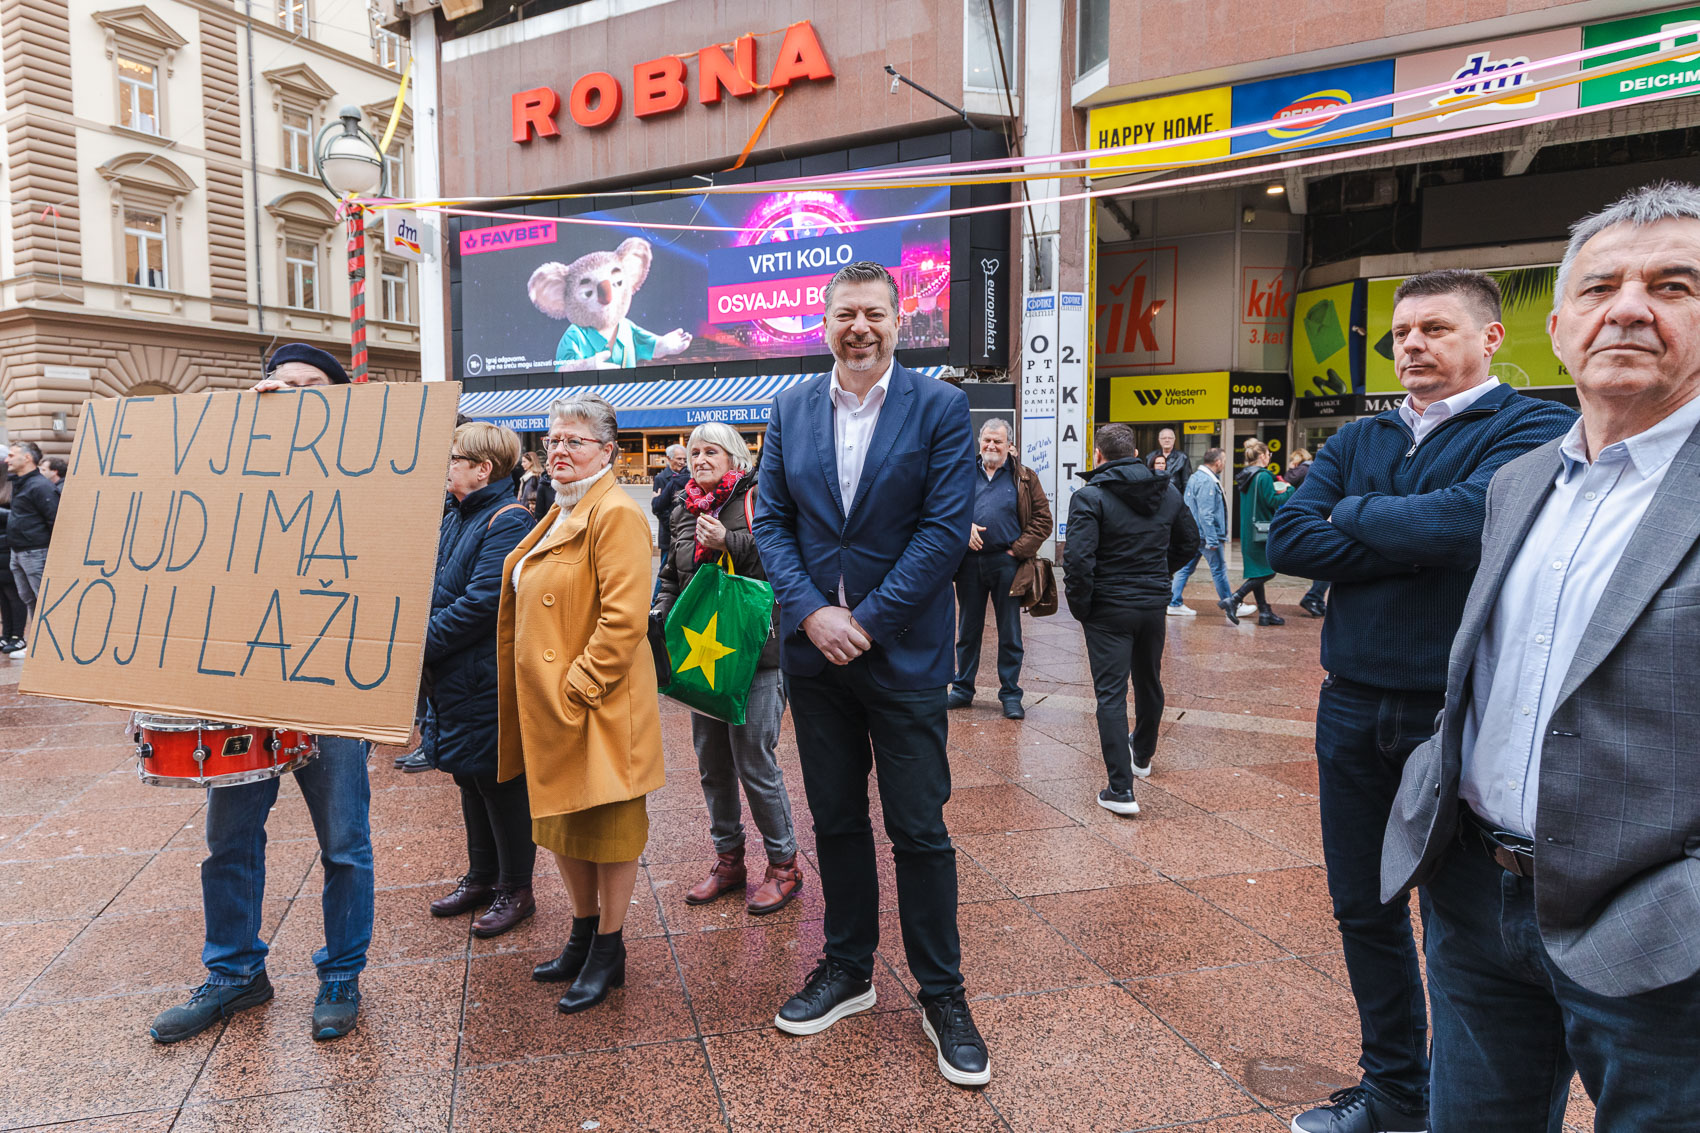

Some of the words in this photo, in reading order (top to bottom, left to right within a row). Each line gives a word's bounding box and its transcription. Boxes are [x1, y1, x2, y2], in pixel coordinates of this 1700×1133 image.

[512, 20, 835, 143] ROBNA
[1453, 56, 1530, 95] dm
[1099, 122, 1155, 149] HAPPY
[398, 218, 418, 242] dm
[481, 224, 552, 247] FAVBET
[749, 252, 791, 274] VRTI
[797, 244, 853, 269] KOLO
[717, 289, 801, 314] OSVAJAJ
[1247, 272, 1291, 319] kik
[986, 279, 997, 351] europlakat
[1249, 328, 1260, 344] 3.
[1263, 330, 1285, 345] kat
[1165, 387, 1207, 397] Western
[1165, 396, 1195, 406] Union
[528, 417, 543, 429] PER
[687, 410, 728, 422] L'AMORE
[730, 409, 748, 421] PER
[750, 408, 759, 420] IL
[1232, 407, 1259, 415] RIJEKA
[73, 397, 154, 477] NE
[173, 384, 429, 478] VJERUJ
[30, 577, 177, 668] KOJI
[196, 579, 401, 691] LAŽU
